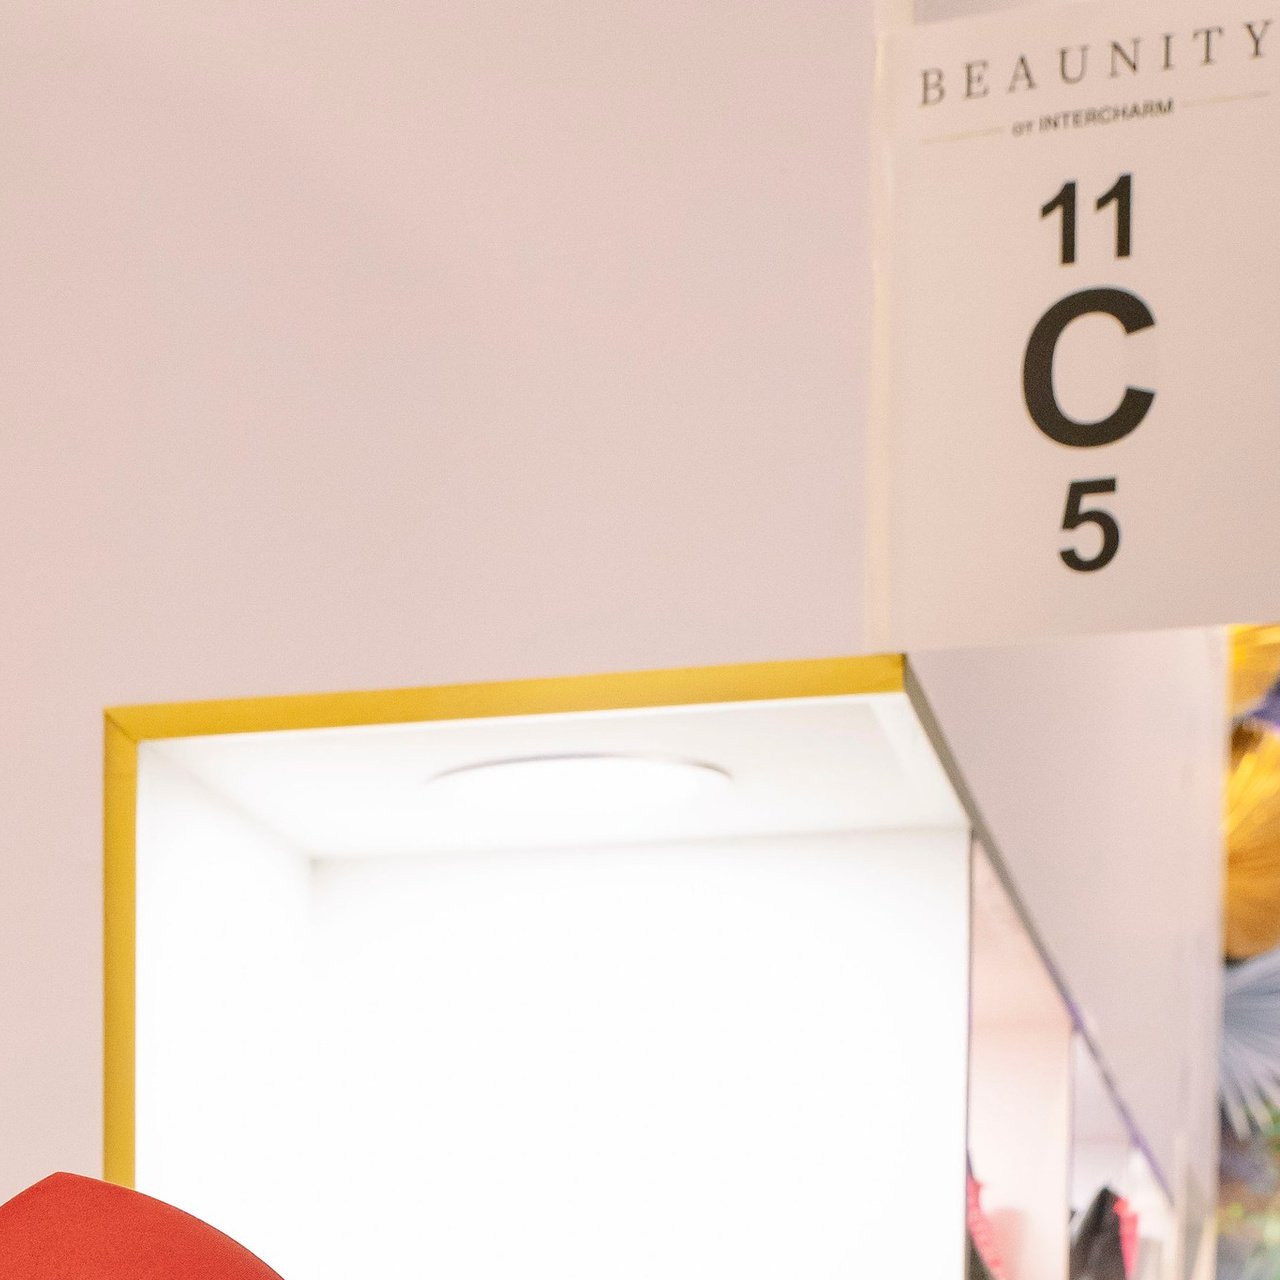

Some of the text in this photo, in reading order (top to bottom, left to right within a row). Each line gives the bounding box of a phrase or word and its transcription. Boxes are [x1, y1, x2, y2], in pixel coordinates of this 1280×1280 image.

[918, 20, 1272, 107] BEAUNITY
[1038, 98, 1175, 133] INTERCHARM
[1040, 172, 1133, 266] 11
[1021, 286, 1156, 449] C
[1058, 476, 1120, 573] 5
